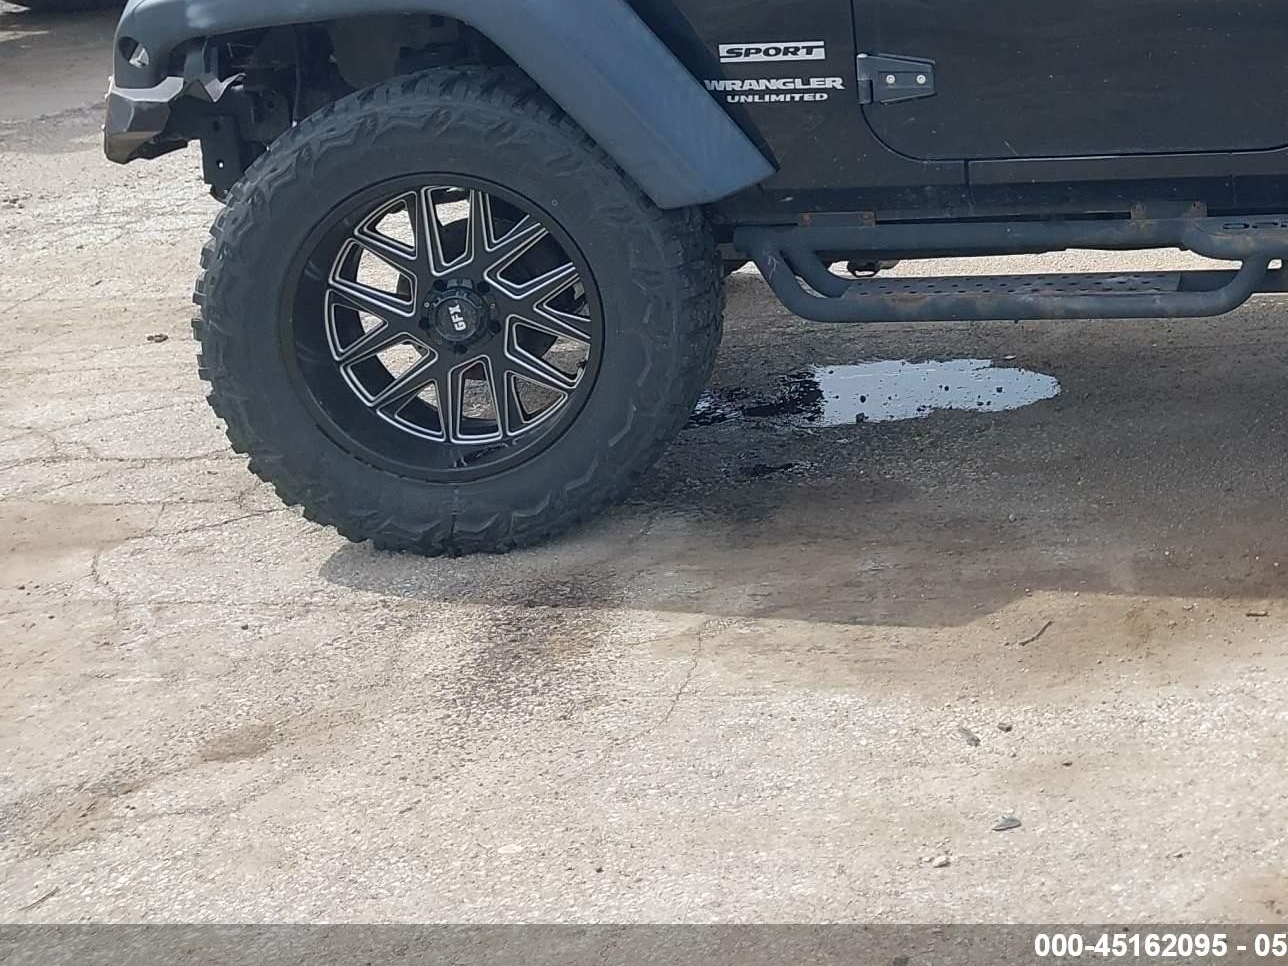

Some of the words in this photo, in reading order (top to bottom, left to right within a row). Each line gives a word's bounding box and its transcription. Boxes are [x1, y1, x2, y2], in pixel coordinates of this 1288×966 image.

[720, 45, 824, 59] SPORT
[704, 77, 846, 90] WRANGLER
[726, 93, 829, 104] UNLIMITED
[448, 304, 467, 331] GFX
